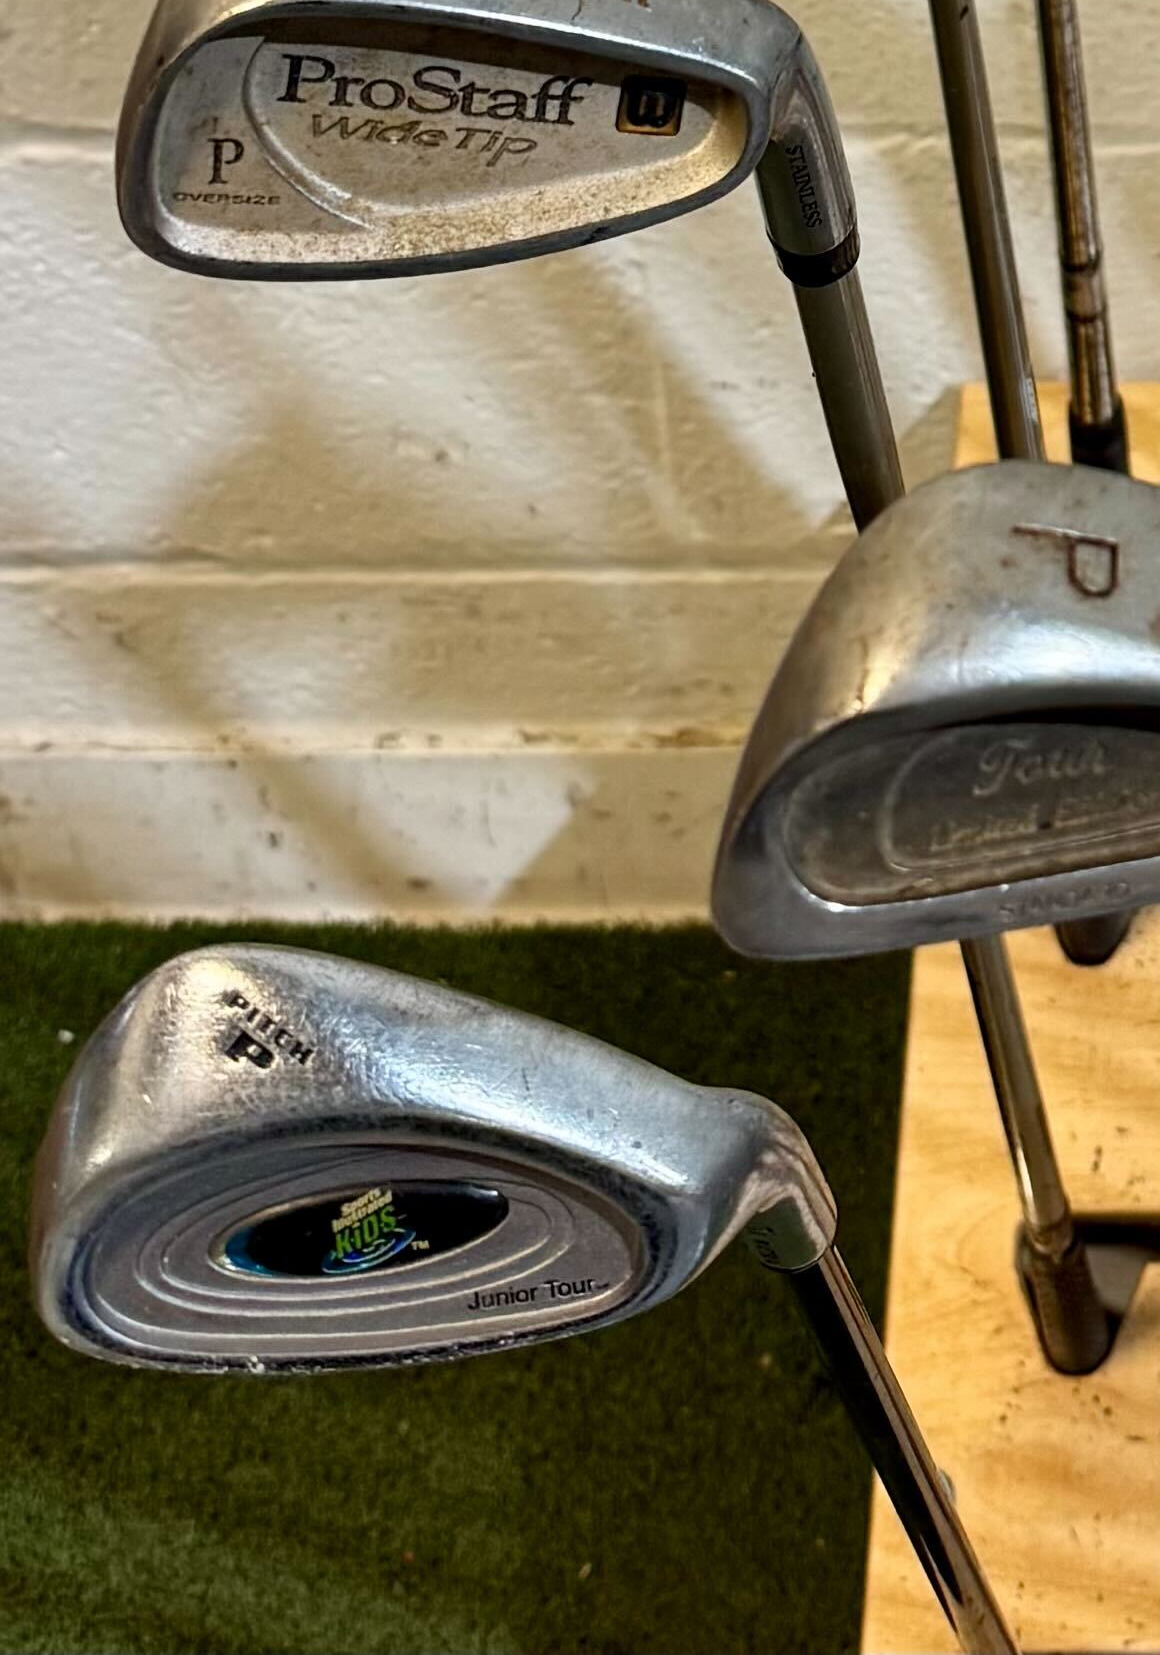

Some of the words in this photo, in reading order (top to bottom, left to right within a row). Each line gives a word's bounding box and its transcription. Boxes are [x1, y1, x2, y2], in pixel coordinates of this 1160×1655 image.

[276, 53, 593, 126] ProStaff
[208, 137, 245, 185] P
[172, 191, 282, 206] OVERSIZE
[1012, 523, 1118, 598] P
[221, 989, 314, 1065] PITCH
[225, 1029, 276, 1069] P
[468, 1287, 538, 1311] Junior
[544, 1278, 594, 1299] Tour
